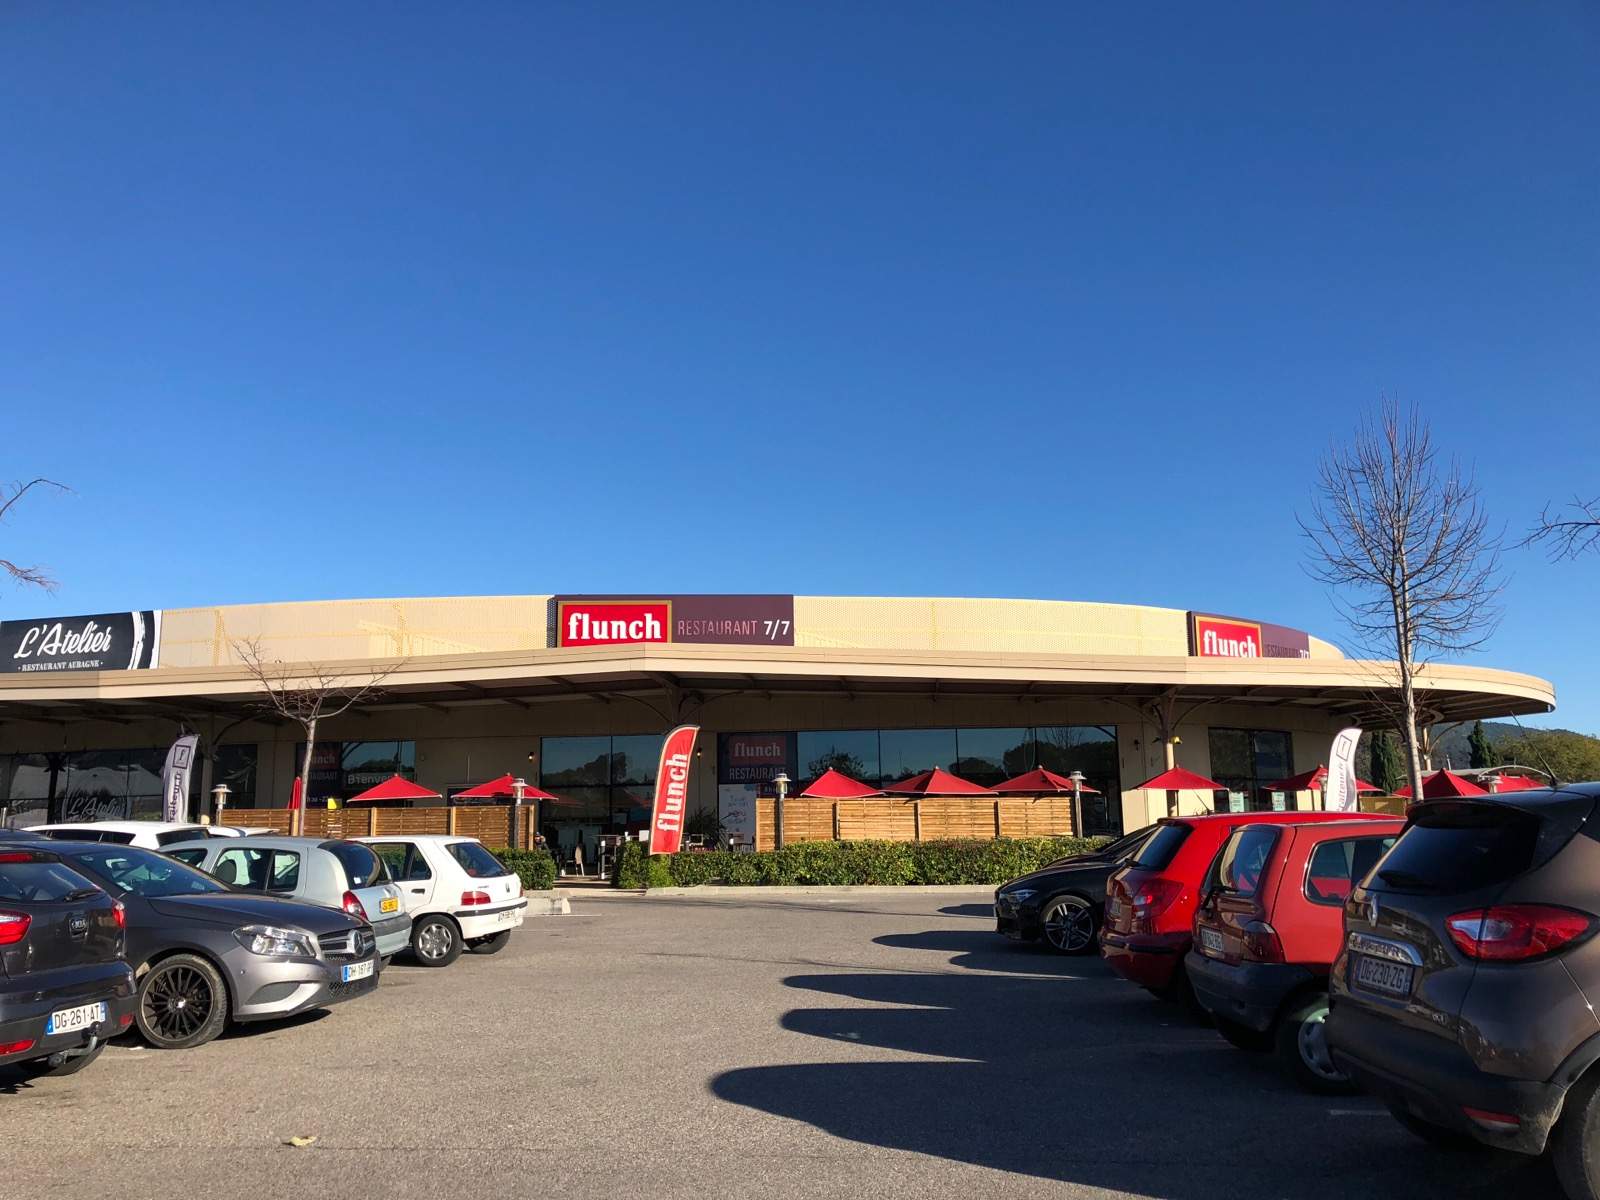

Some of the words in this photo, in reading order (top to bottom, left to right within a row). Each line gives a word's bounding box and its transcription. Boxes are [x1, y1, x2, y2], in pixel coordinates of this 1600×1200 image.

[567, 612, 662, 640] flunch
[677, 620, 758, 636] RESTAURANT
[763, 620, 790, 640] 7/7
[13, 620, 112, 659] L'Atelier
[1203, 630, 1257, 658] flunch
[21, 661, 66, 672] RESTAURANT
[68, 659, 100, 669] AUBAGNE
[734, 742, 781, 758] flunch
[656, 753, 688, 832] flunch
[54, 1004, 100, 1029] DG-261-AT
